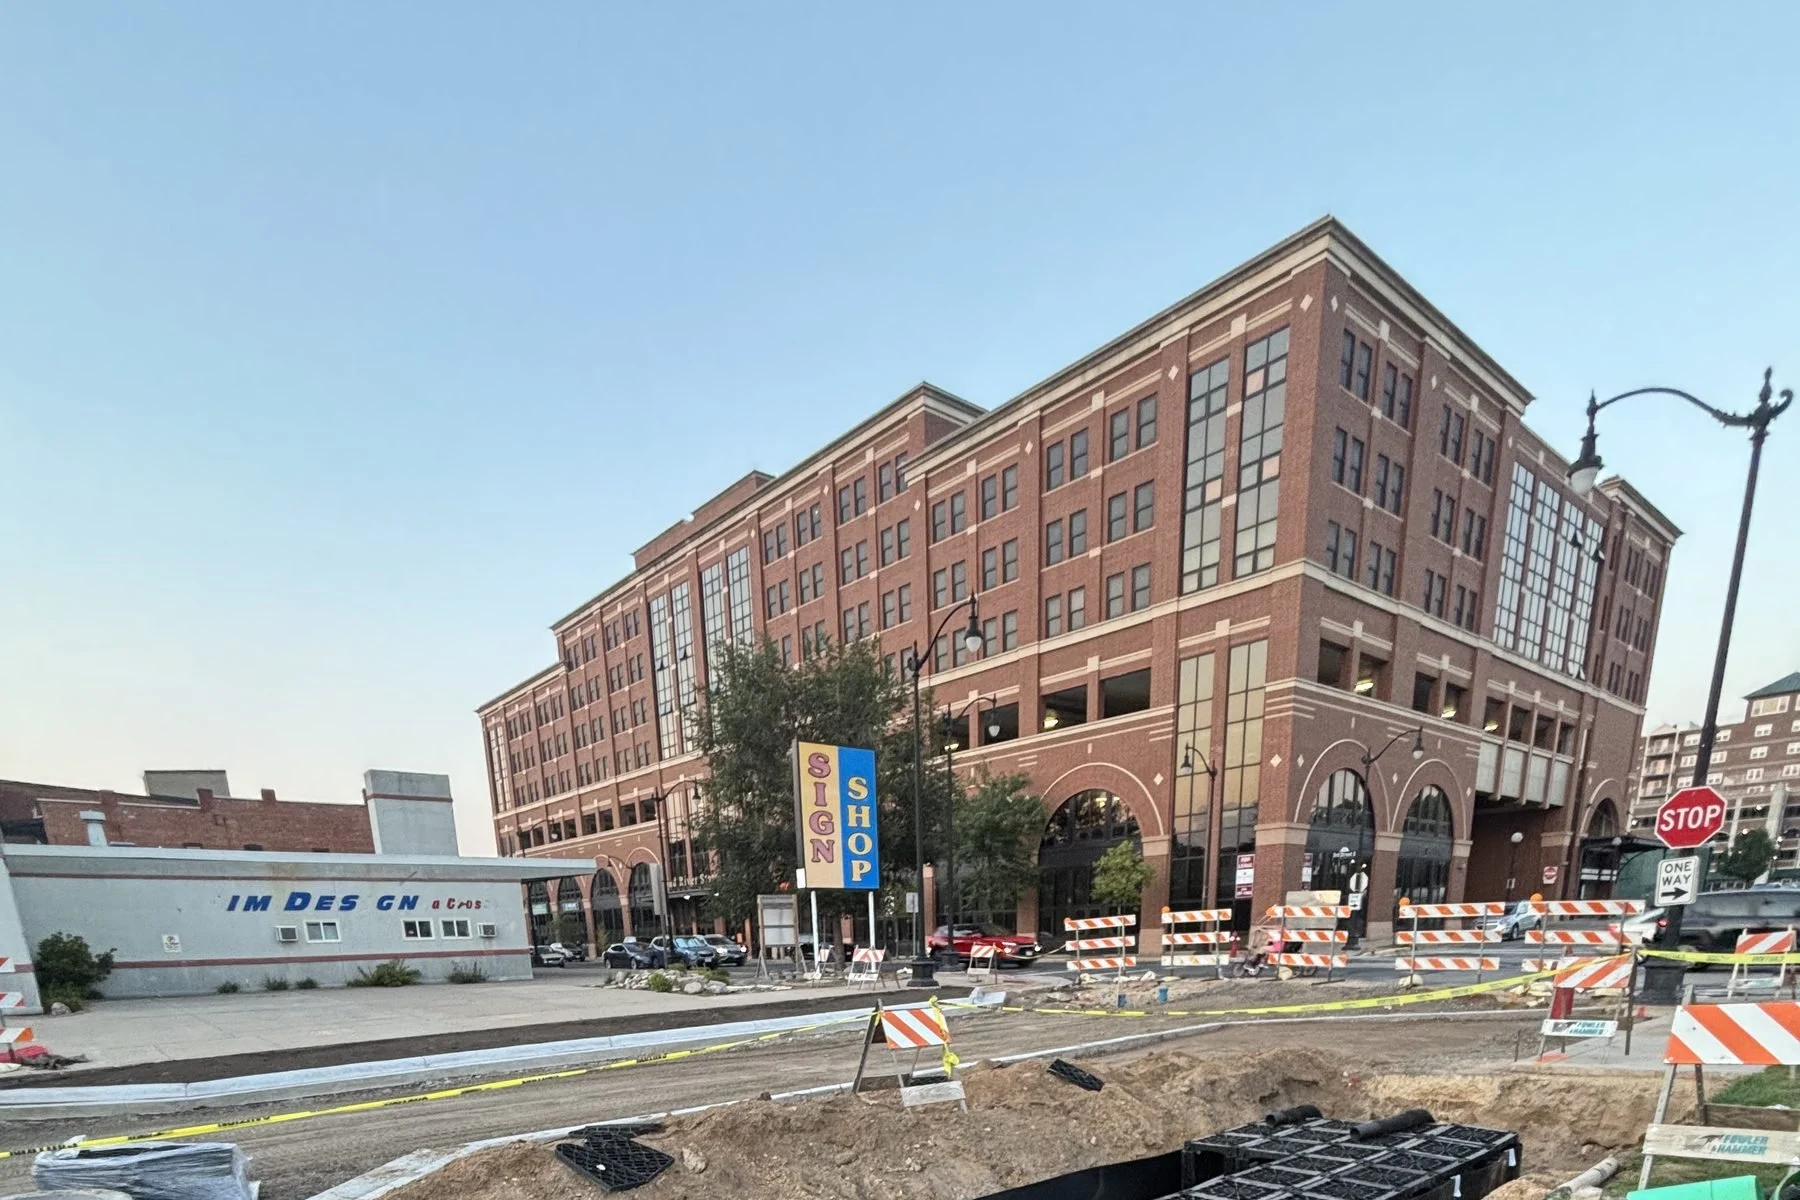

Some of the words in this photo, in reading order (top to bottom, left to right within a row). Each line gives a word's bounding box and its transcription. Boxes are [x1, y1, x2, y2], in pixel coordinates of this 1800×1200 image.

[808, 752, 835, 863] SIGN
[1660, 805, 1721, 831] STOP
[847, 776, 872, 882] SHOP
[1664, 861, 1692, 873] ONE
[1662, 874, 1691, 886] WAY
[1723, 1134, 1769, 1145] FOWLER
[1717, 1144, 1768, 1155] HAMMER
